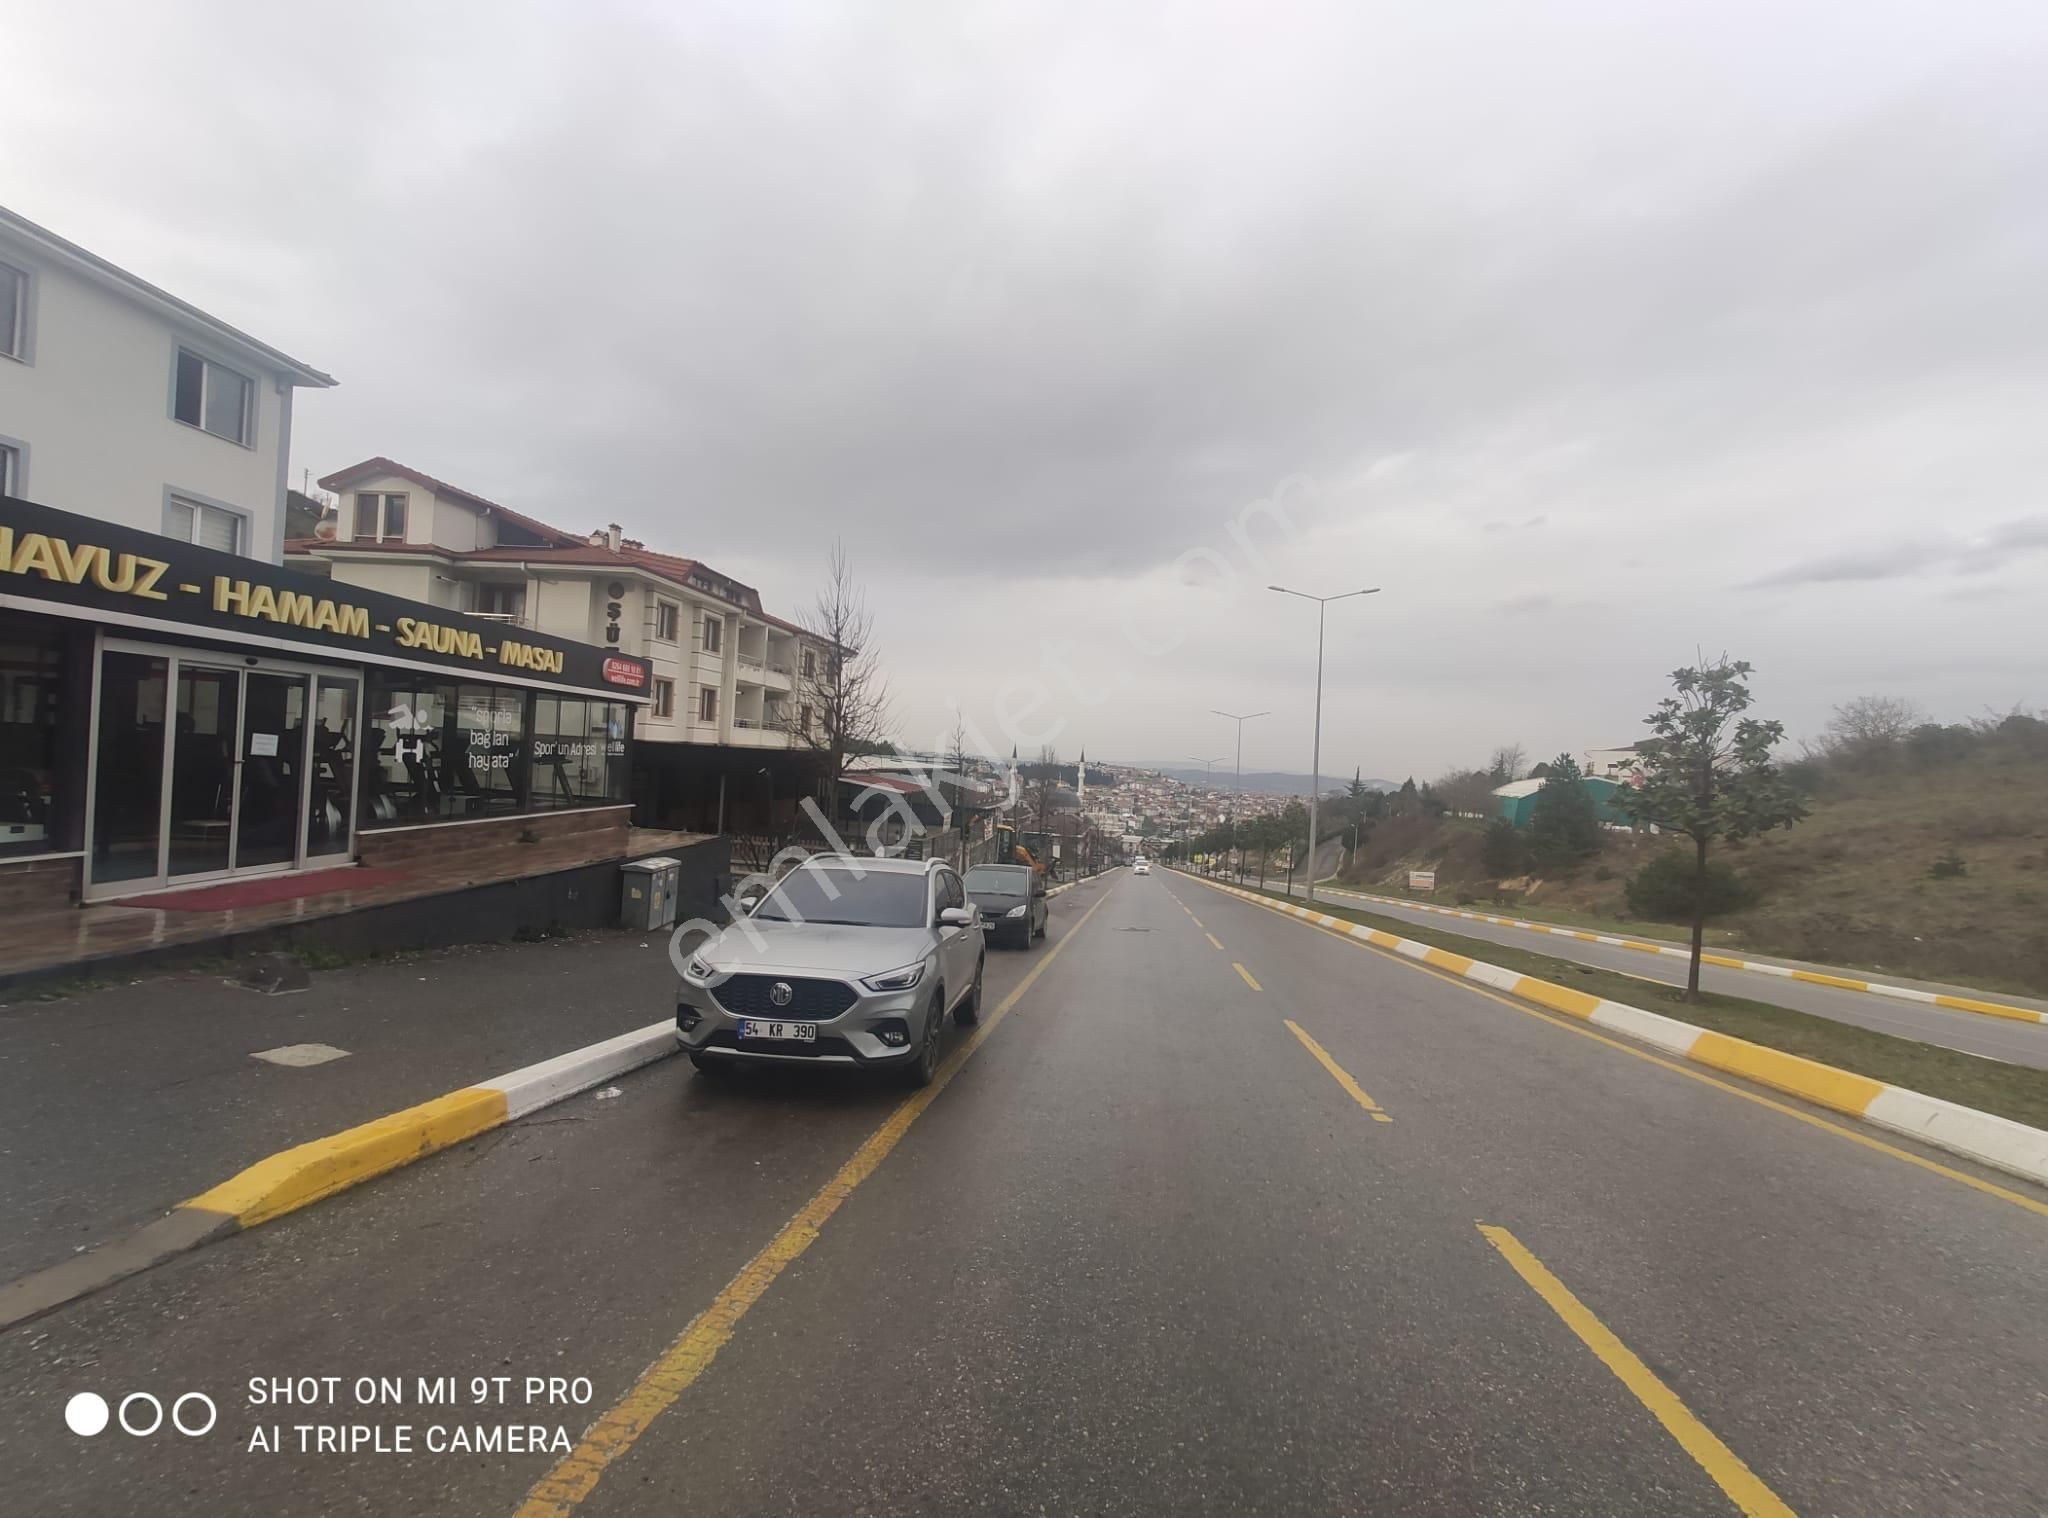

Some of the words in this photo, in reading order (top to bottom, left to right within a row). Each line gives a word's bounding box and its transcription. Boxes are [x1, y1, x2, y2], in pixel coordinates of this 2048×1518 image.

[213, 575, 369, 639] HAMAM
[395, 617, 484, 660] SAUNA
[499, 640, 564, 674] MASAJ
[745, 1022, 758, 1036] 54
[769, 1023, 783, 1037] KR
[793, 1025, 815, 1039] 390
